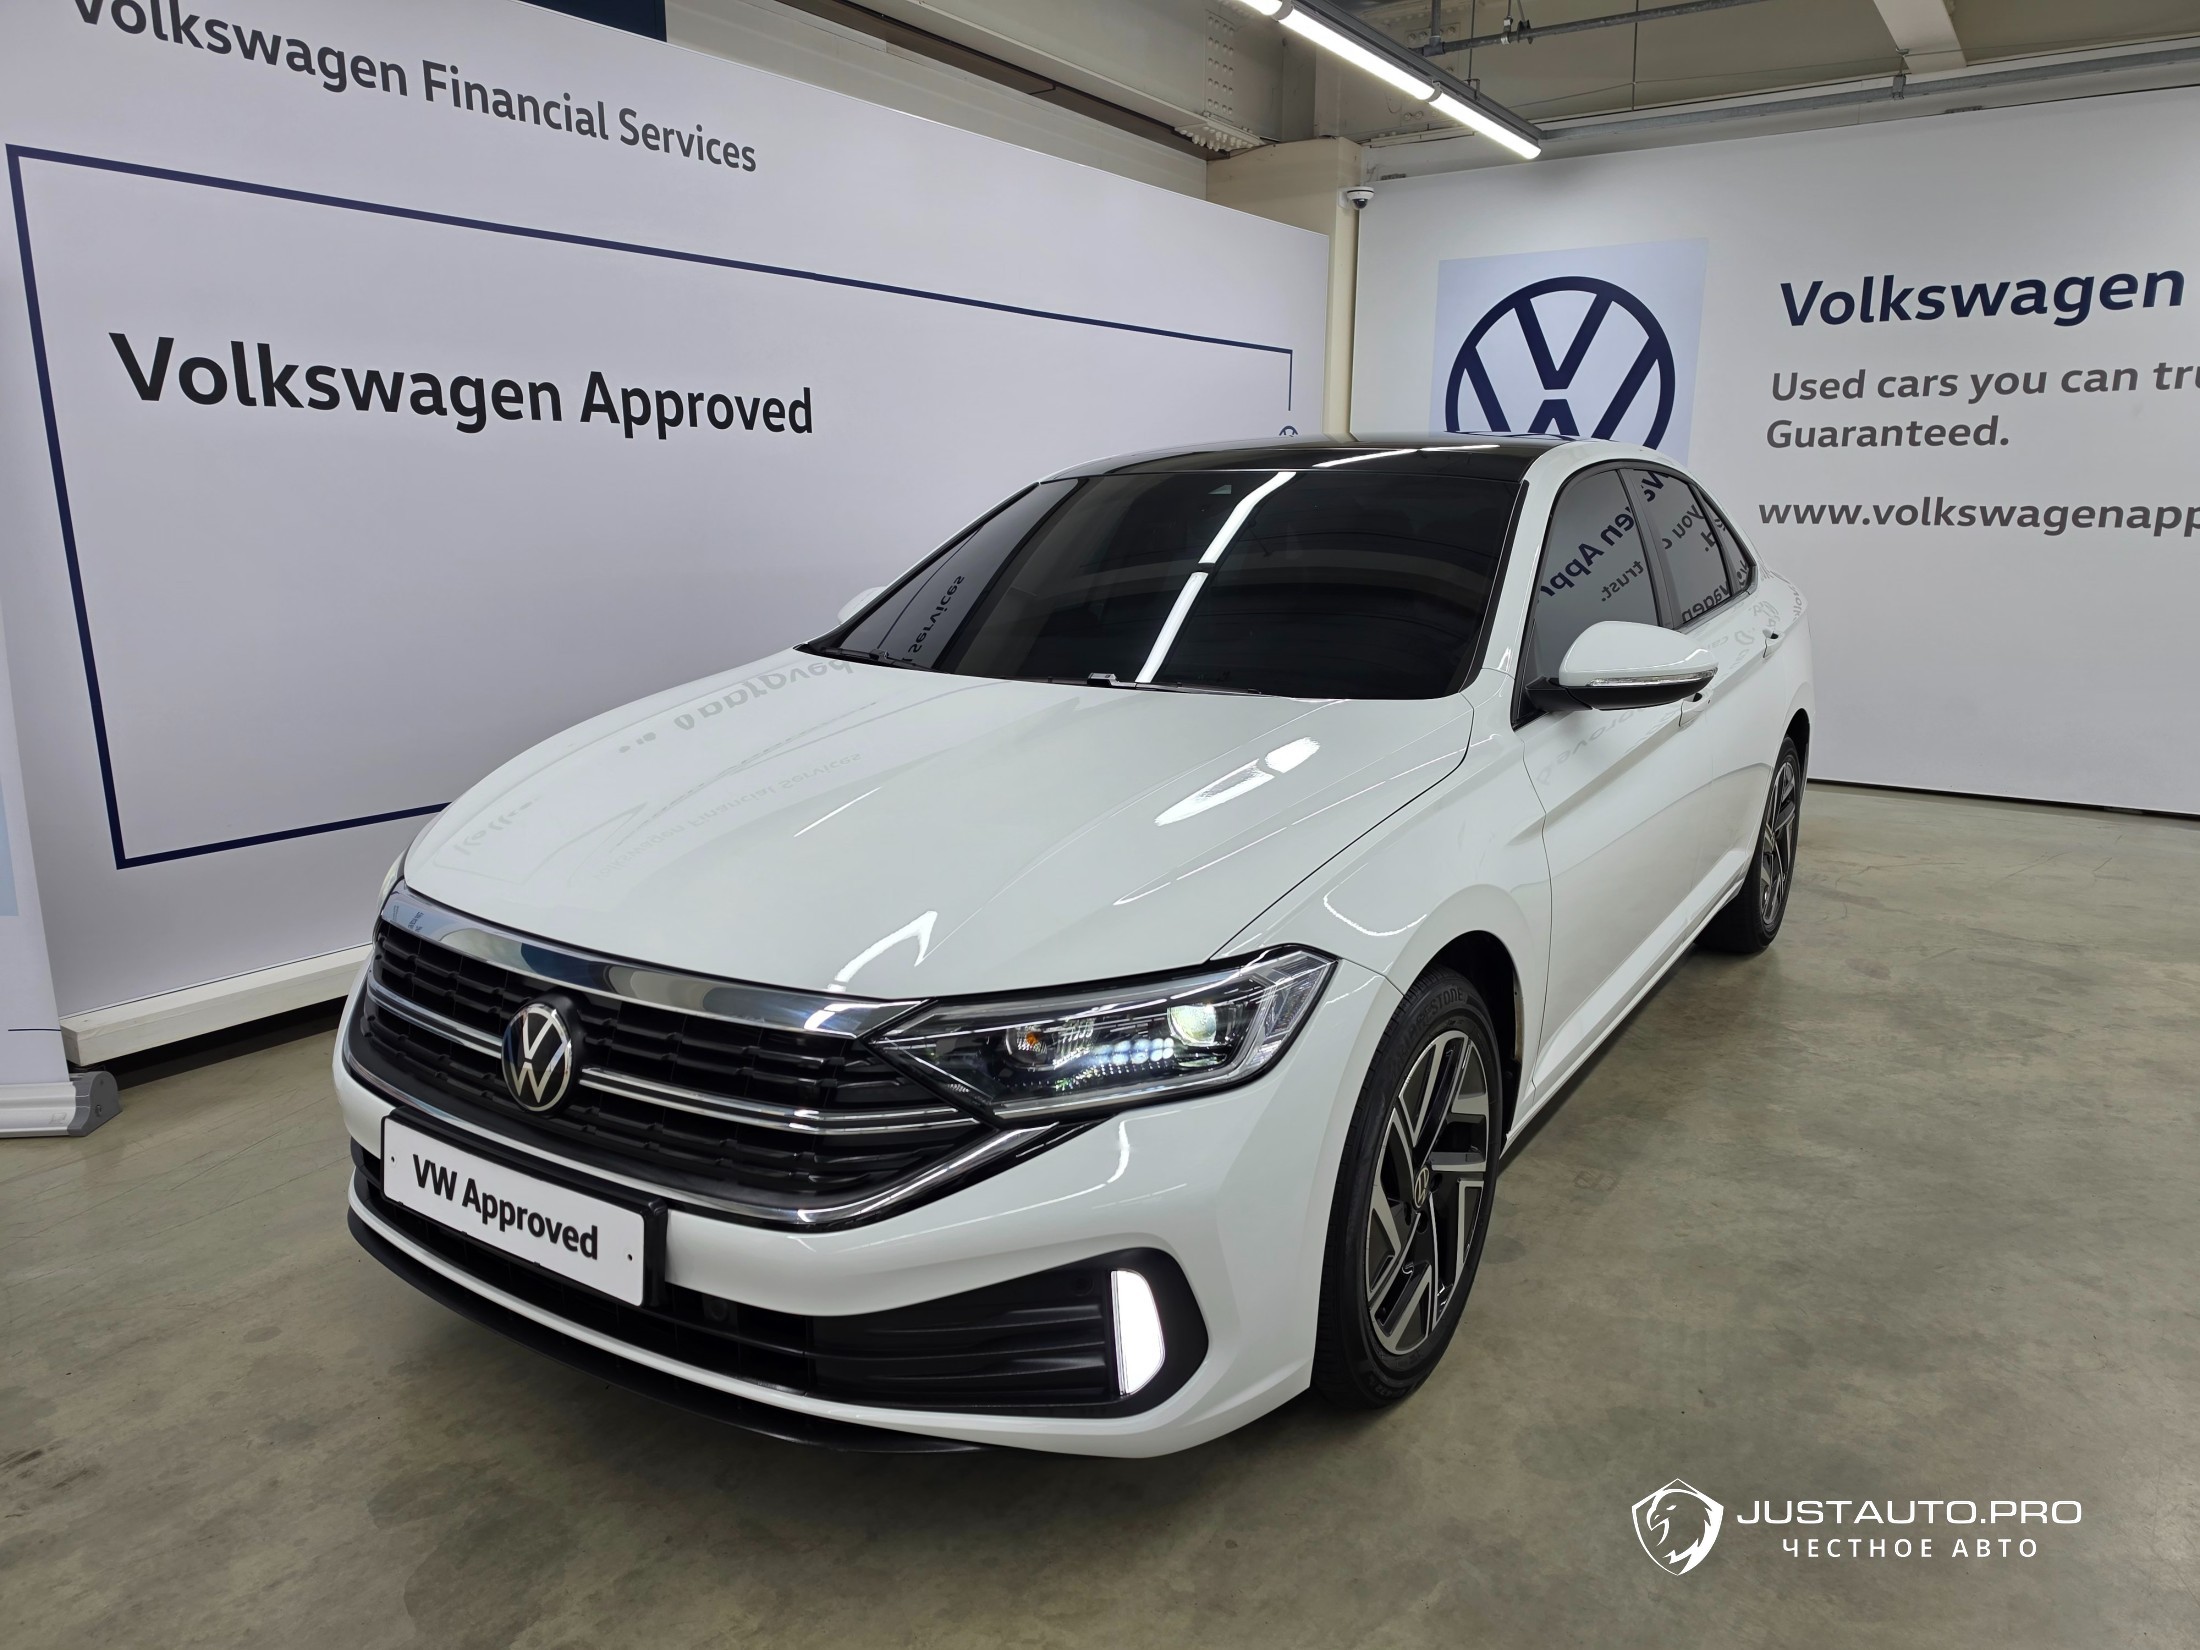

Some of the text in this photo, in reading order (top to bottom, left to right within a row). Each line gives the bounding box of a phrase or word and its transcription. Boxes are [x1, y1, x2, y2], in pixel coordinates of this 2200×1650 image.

[422, 59, 609, 141] Financial
[618, 107, 757, 172] Services
[1780, 270, 2185, 327] Volkswagen
[108, 332, 813, 441] Volkswagen Approved
[1772, 362, 2200, 405] Used cars you can tr
[1766, 415, 2009, 449] Guaranteed.
[412, 1153, 598, 1260] VW Approved
